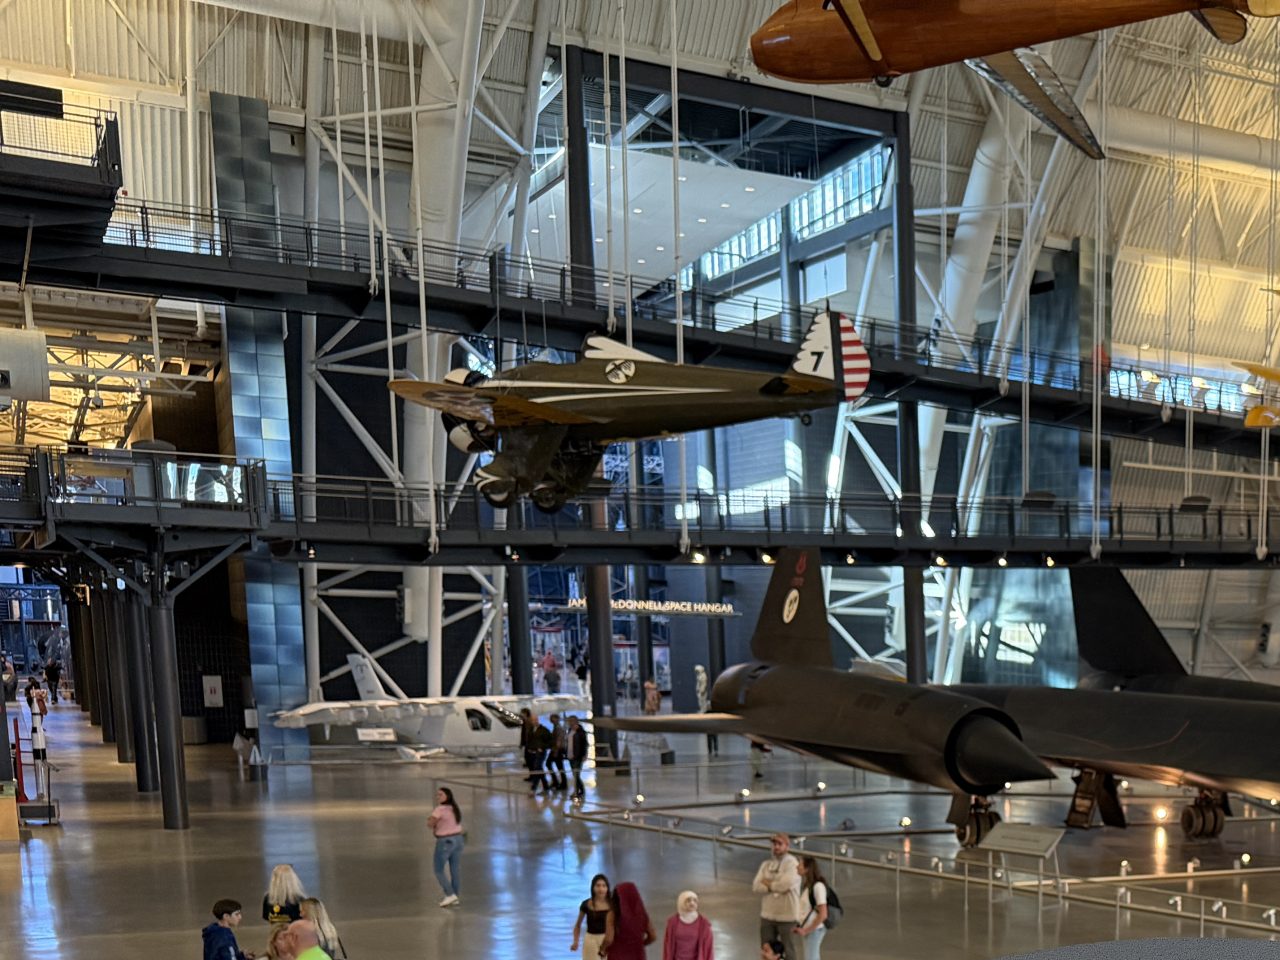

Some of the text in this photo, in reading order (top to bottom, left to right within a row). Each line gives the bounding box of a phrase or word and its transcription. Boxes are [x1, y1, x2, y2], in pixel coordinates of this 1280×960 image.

[810, 351, 824, 372] 7
[568, 598, 587, 608] JAM
[665, 601, 692, 612] SPACE
[693, 603, 733, 613] HANGAR
